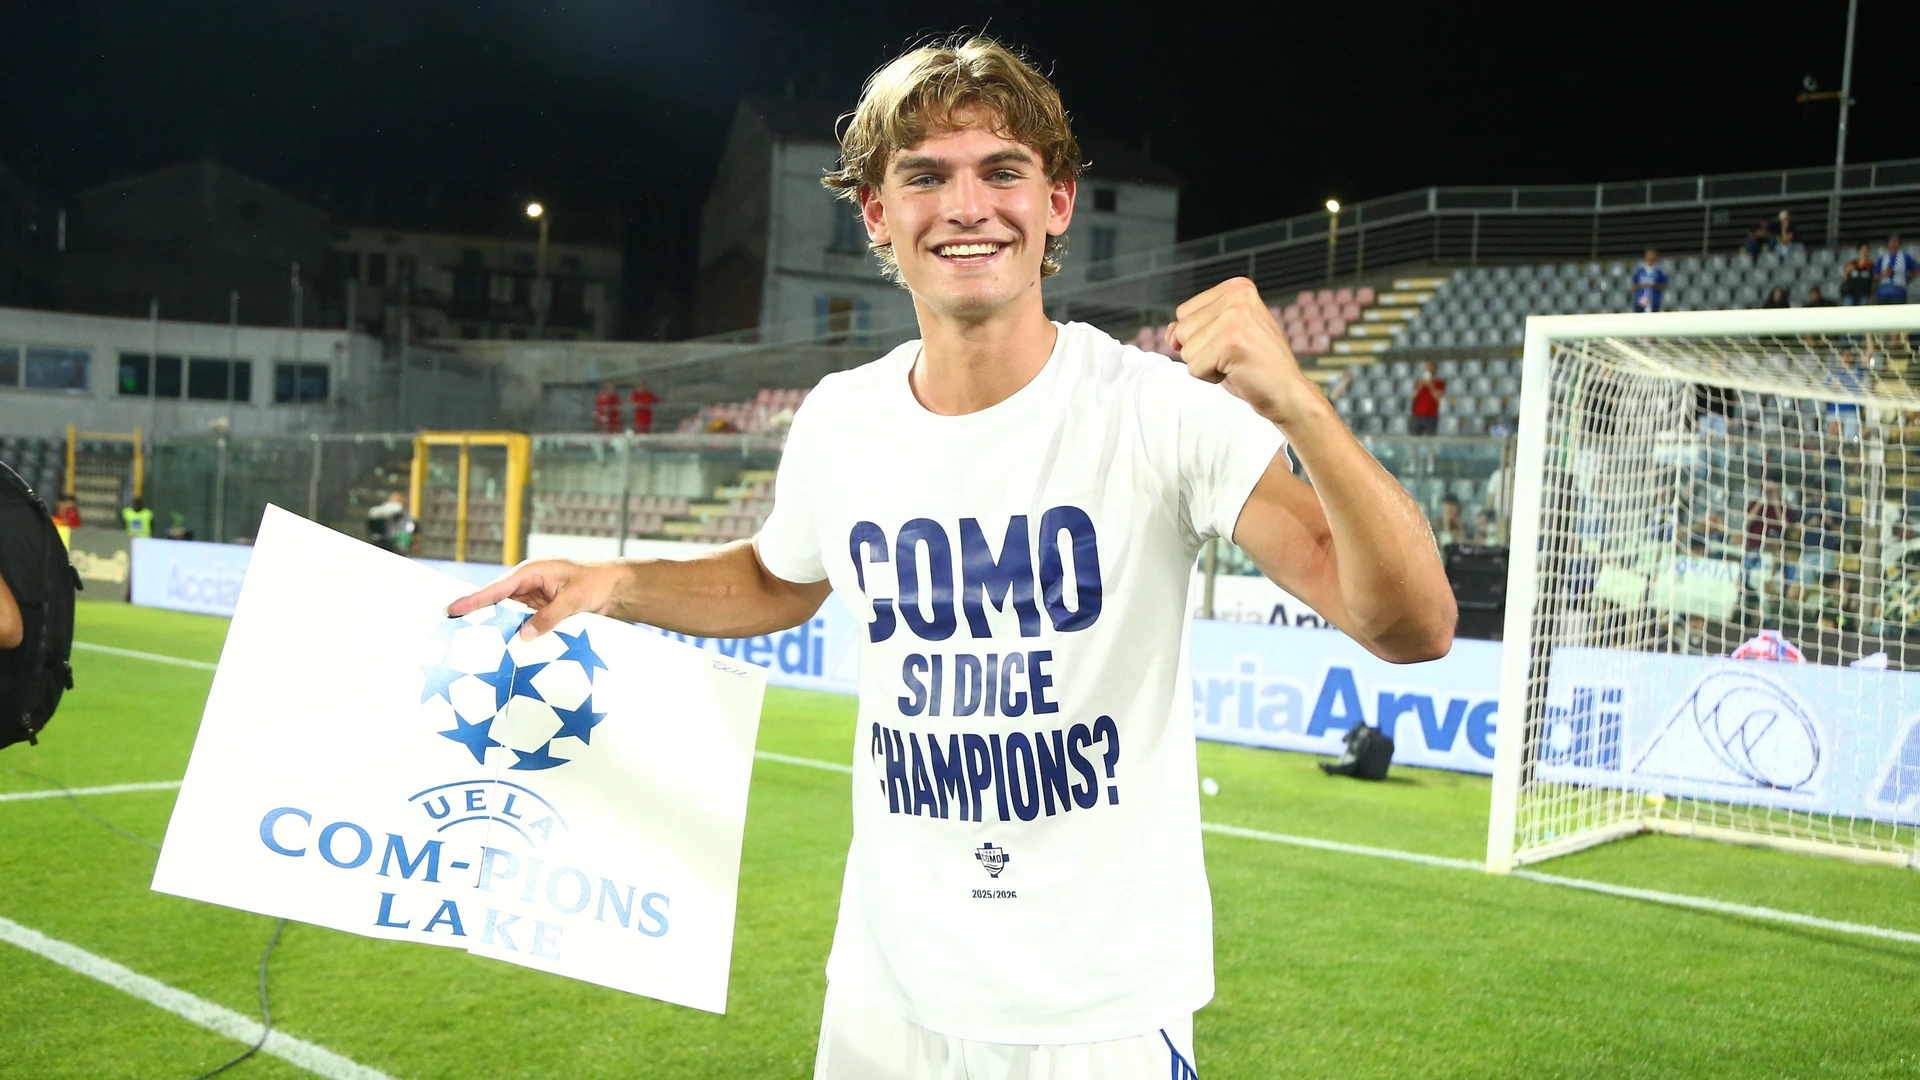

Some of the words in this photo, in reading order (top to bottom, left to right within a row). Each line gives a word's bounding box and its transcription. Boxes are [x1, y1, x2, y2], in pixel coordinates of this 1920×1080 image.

[850, 505, 1102, 643] COMO
[167, 562, 247, 606] Accia
[661, 618, 824, 678] vedi
[898, 653, 943, 717] SI
[953, 650, 1060, 718] DICE
[871, 715, 1120, 823] CHAMPIONS?
[423, 788, 559, 842] UELA
[259, 806, 670, 938] COM-PIONS
[972, 889, 1018, 899] 2025/2026
[374, 891, 565, 961] LAKE
